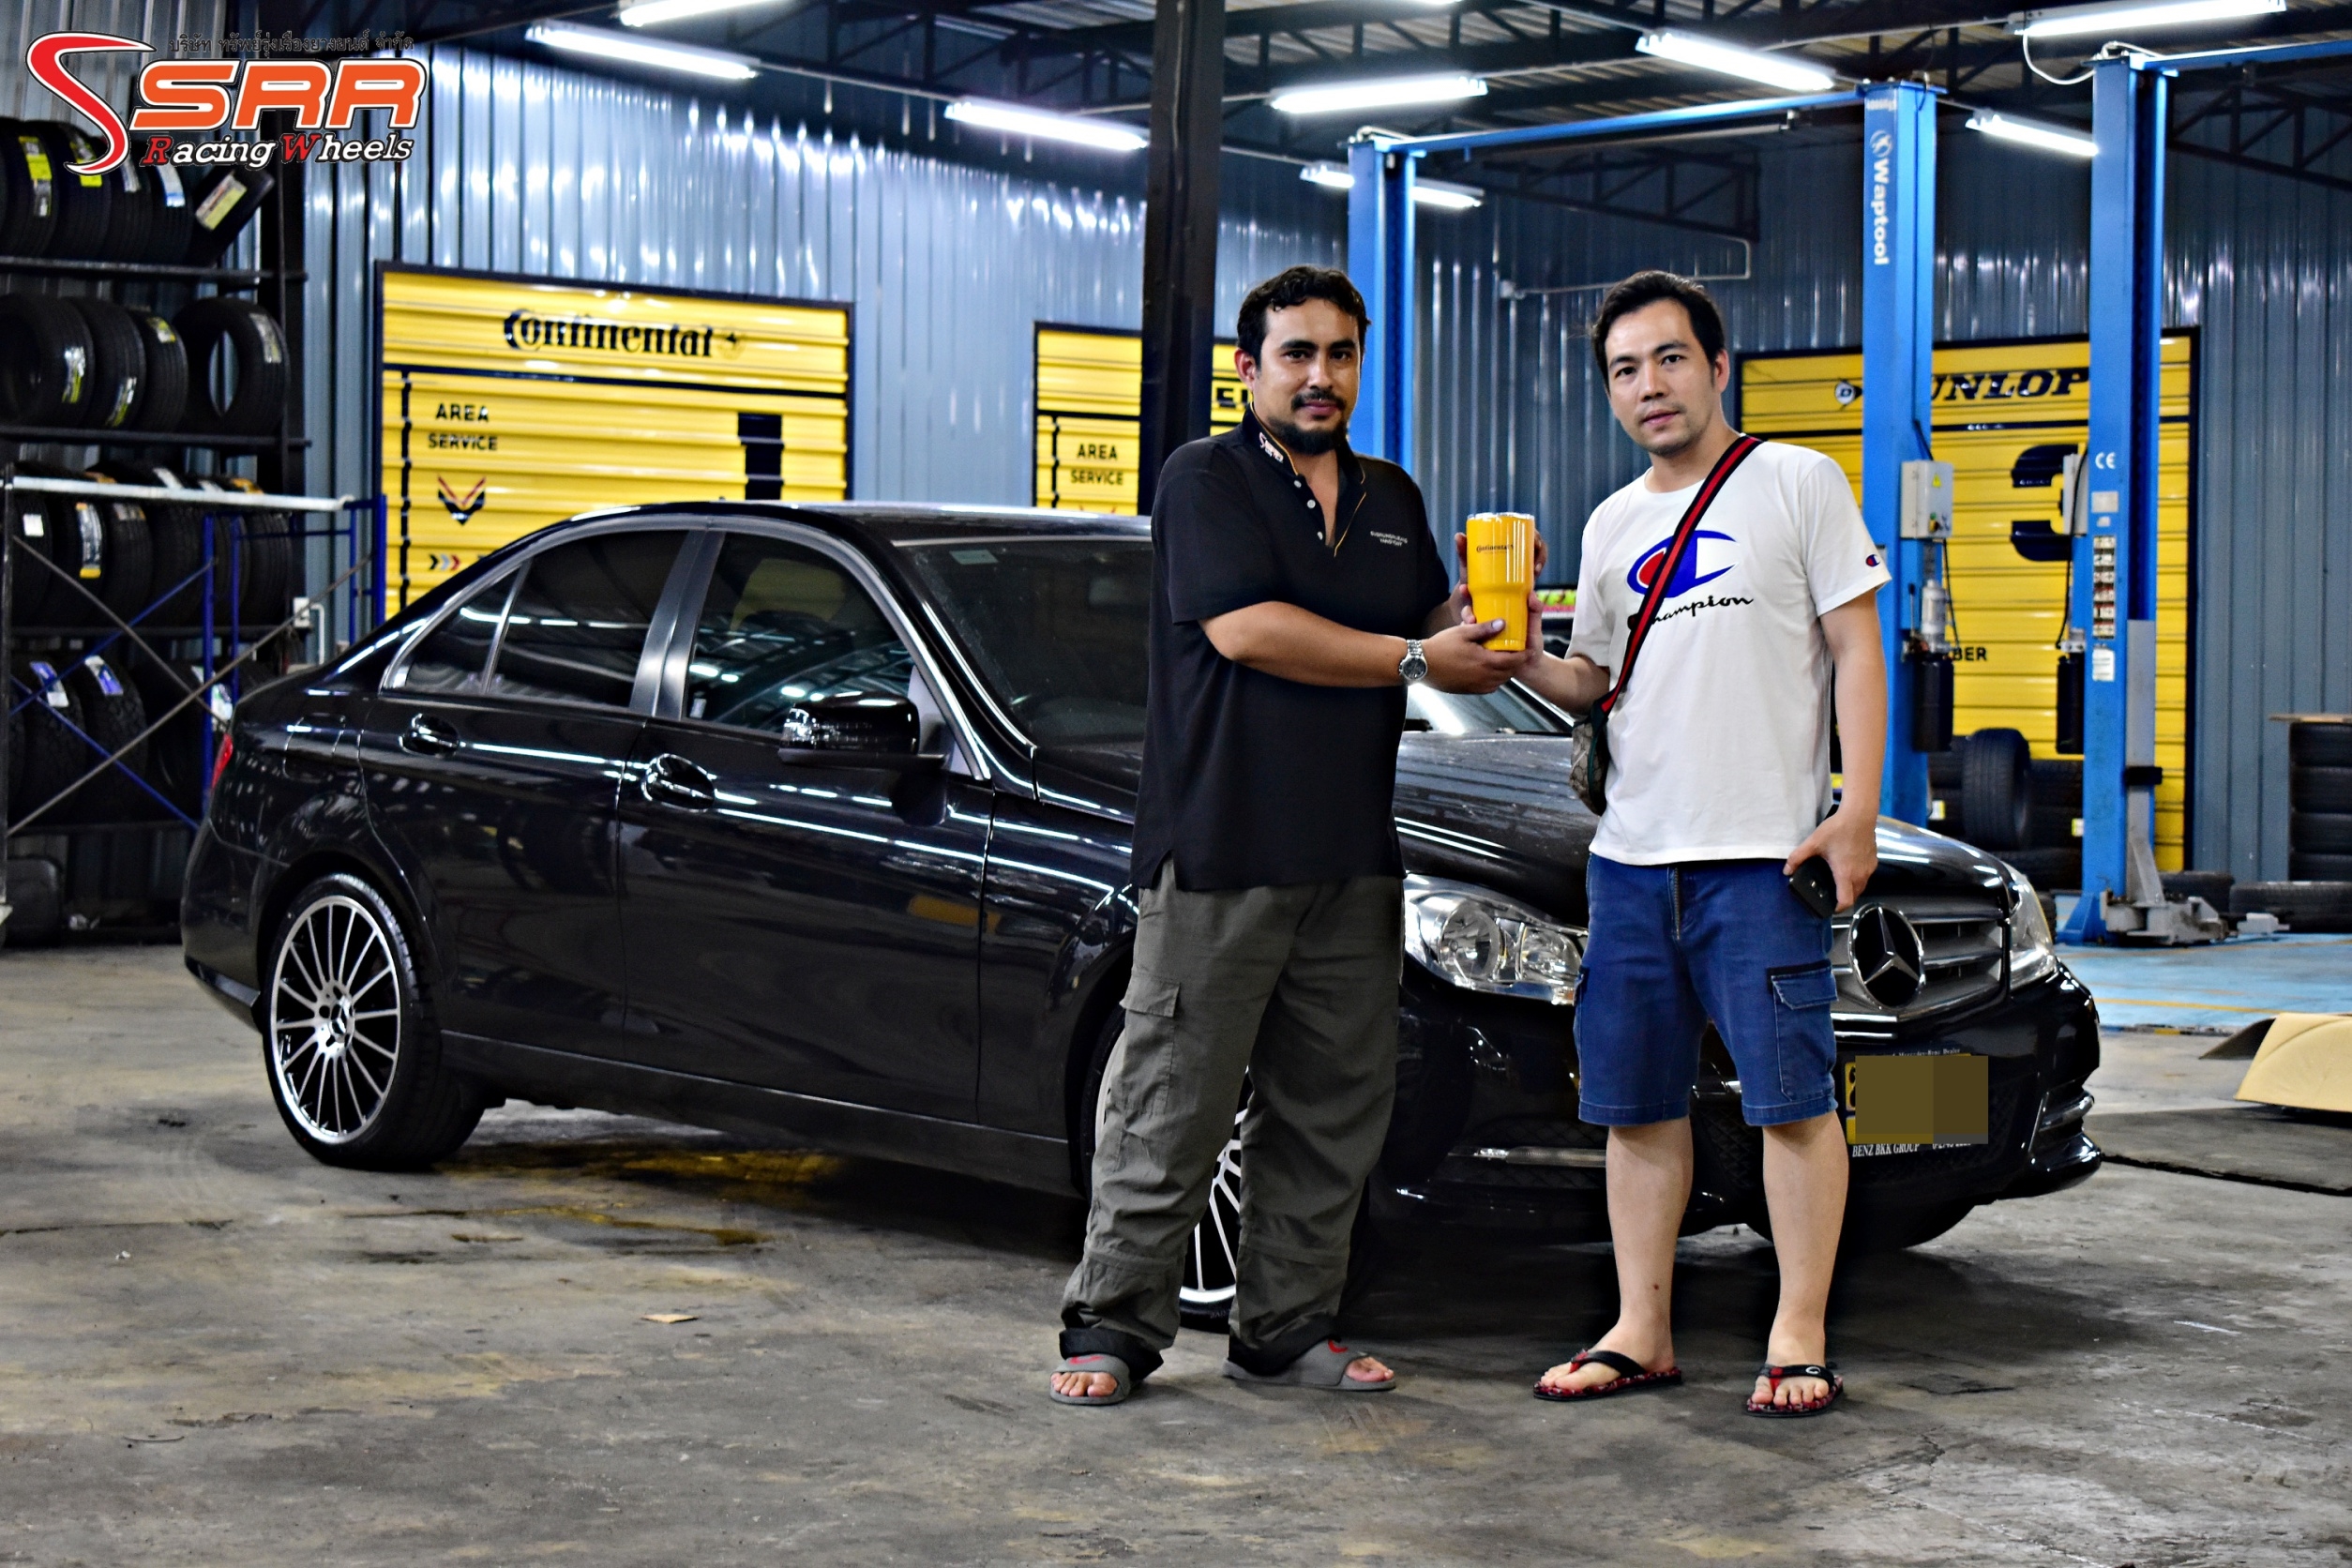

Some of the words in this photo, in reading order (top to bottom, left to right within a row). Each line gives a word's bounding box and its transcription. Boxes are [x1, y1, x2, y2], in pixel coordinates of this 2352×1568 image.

[1870, 157, 1890, 265] Waptool
[504, 309, 713, 357] Continental
[1932, 366, 2088, 401] NLOP
[435, 403, 489, 422] AREA
[428, 432, 498, 451] SERVICE
[1077, 443, 1118, 460] AREA
[1071, 469, 1123, 486] SERVICE
[1852, 1145, 1874, 1157] BENZ
[1892, 1143, 1921, 1154] GROUP
